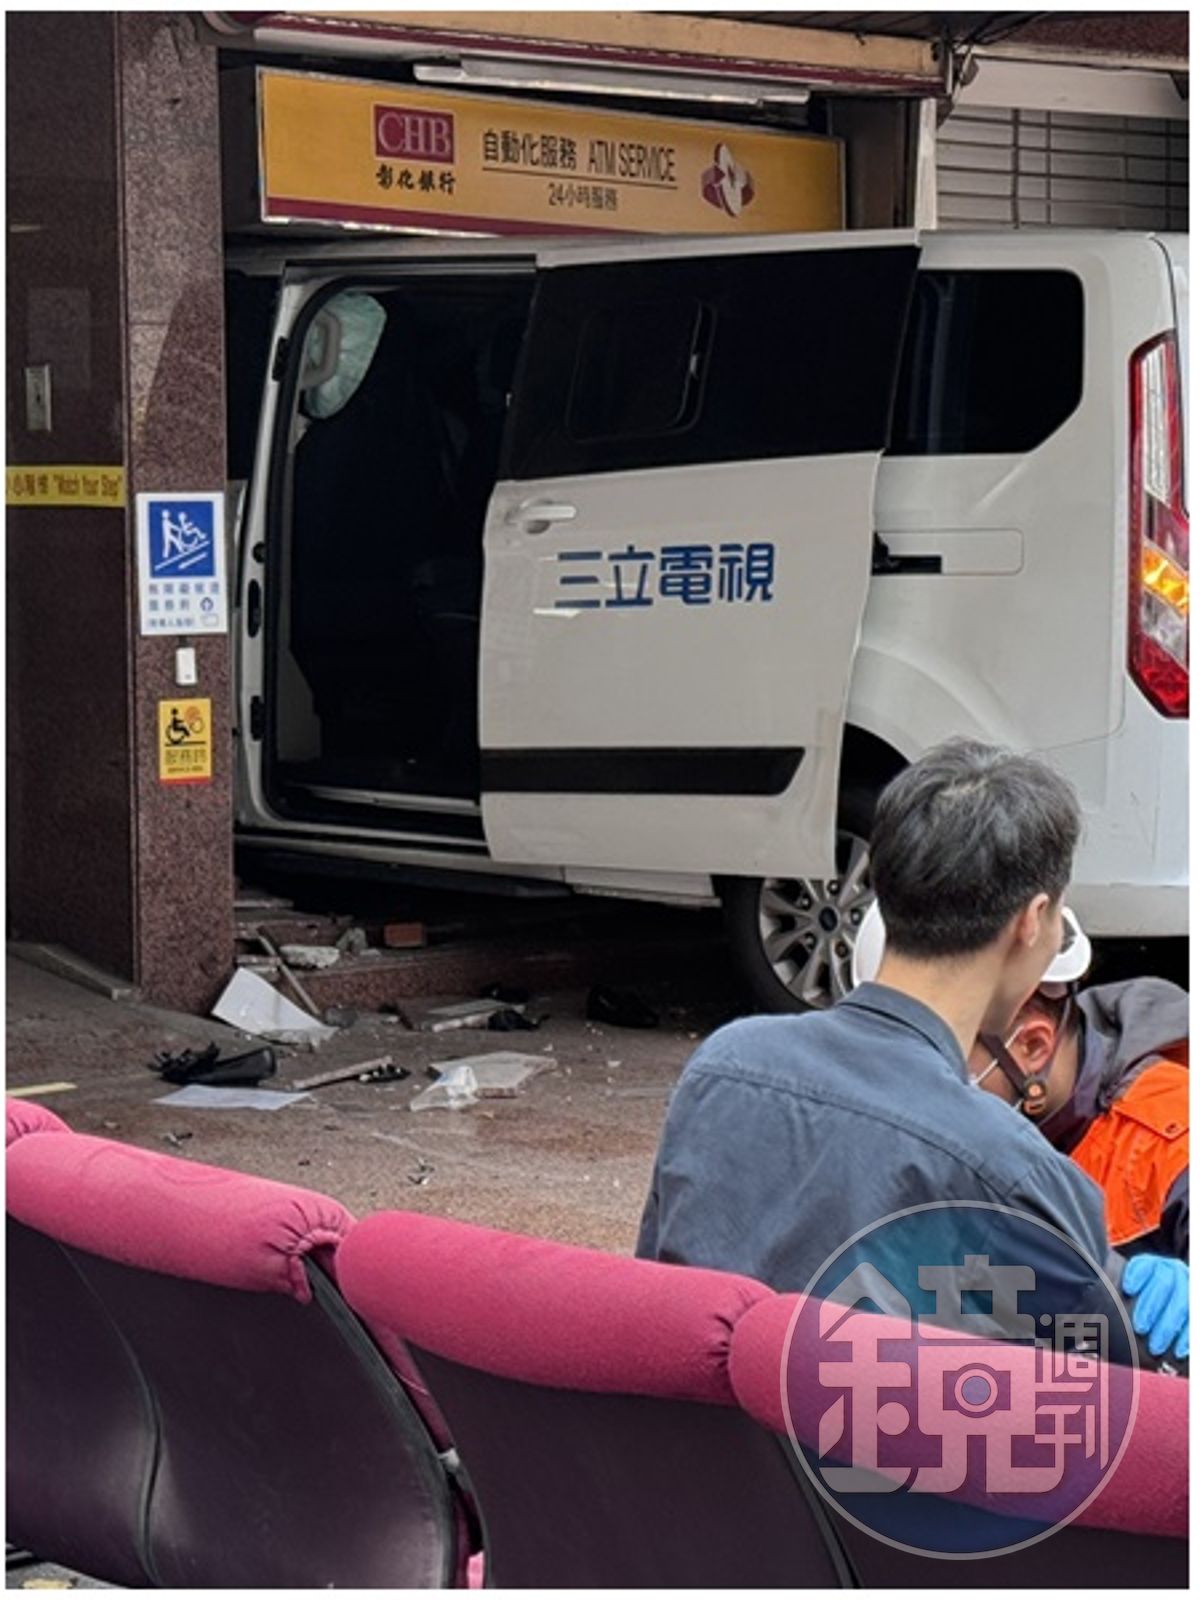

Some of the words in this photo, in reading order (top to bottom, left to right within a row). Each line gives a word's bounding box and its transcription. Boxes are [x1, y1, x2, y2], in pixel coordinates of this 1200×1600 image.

[378, 109, 453, 160] CHB
[482, 129, 577, 170] 自動化服務
[587, 142, 616, 178] ATM
[618, 143, 677, 183] SERVICE
[376, 164, 456, 196] 彰化銀行
[548, 183, 619, 211] 24小時服務
[554, 542, 776, 609] 三立電視
